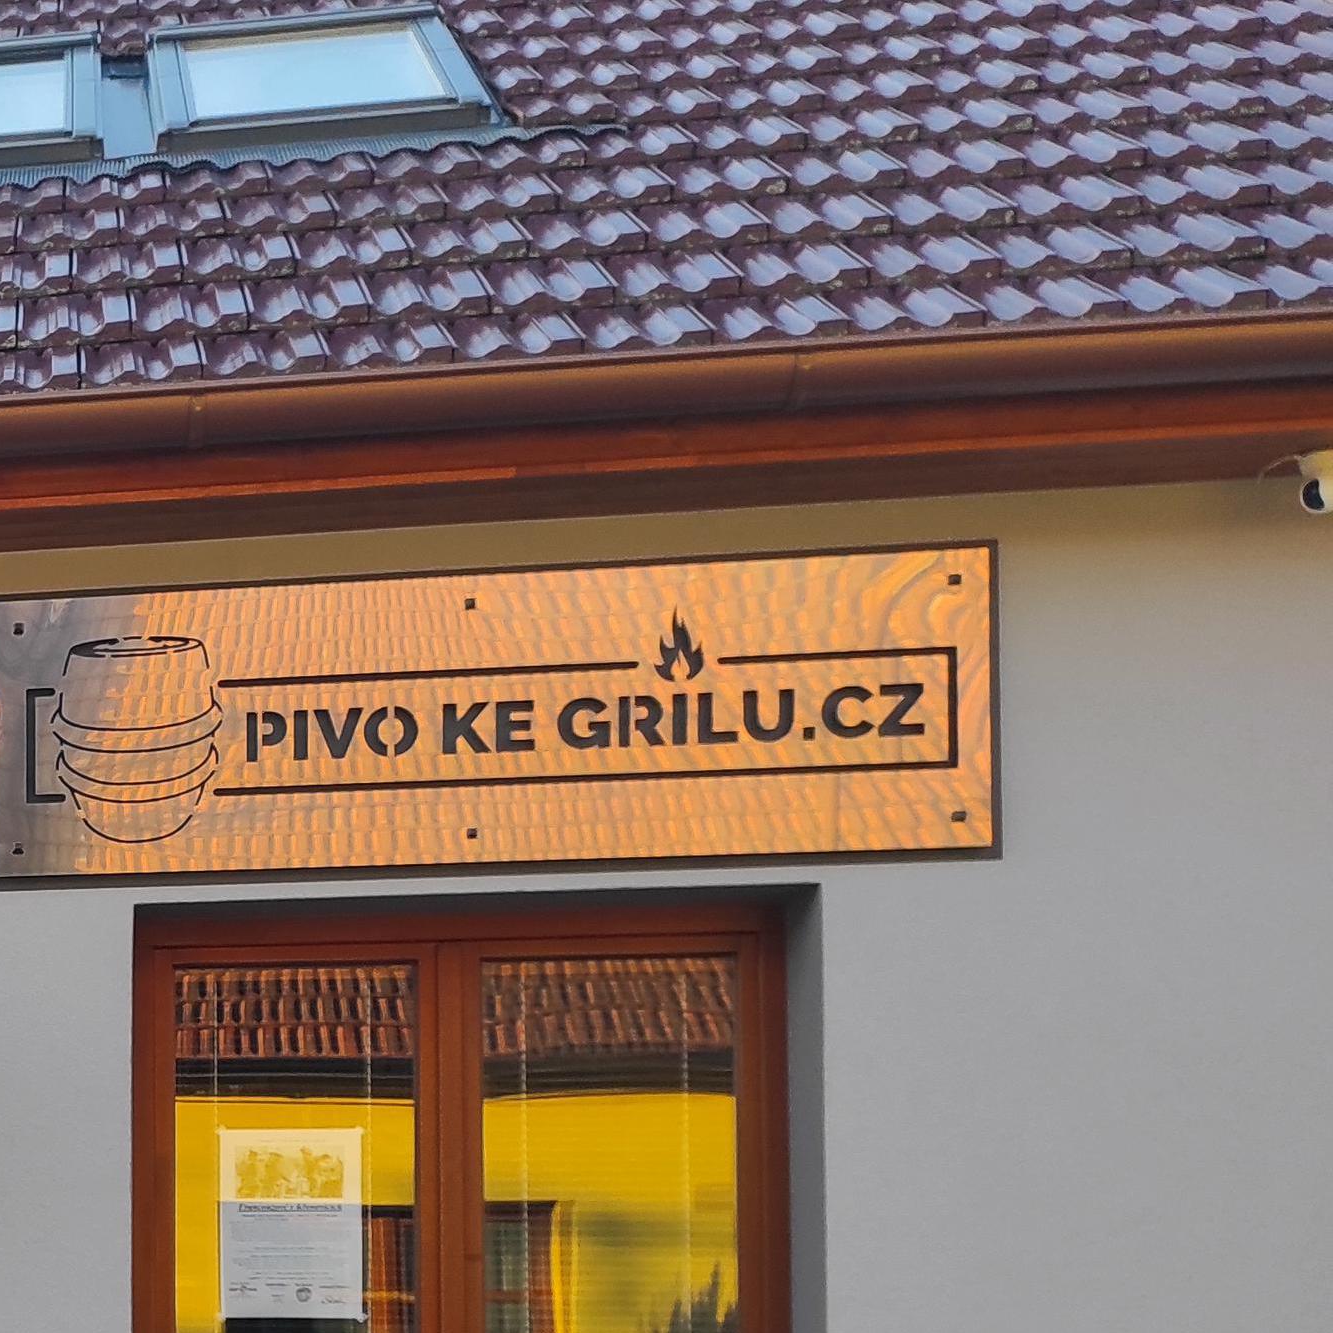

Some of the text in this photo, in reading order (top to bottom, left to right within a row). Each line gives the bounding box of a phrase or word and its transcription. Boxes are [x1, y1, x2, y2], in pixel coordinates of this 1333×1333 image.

[245, 682, 926, 763] PIVO KE GRILU.CZ
